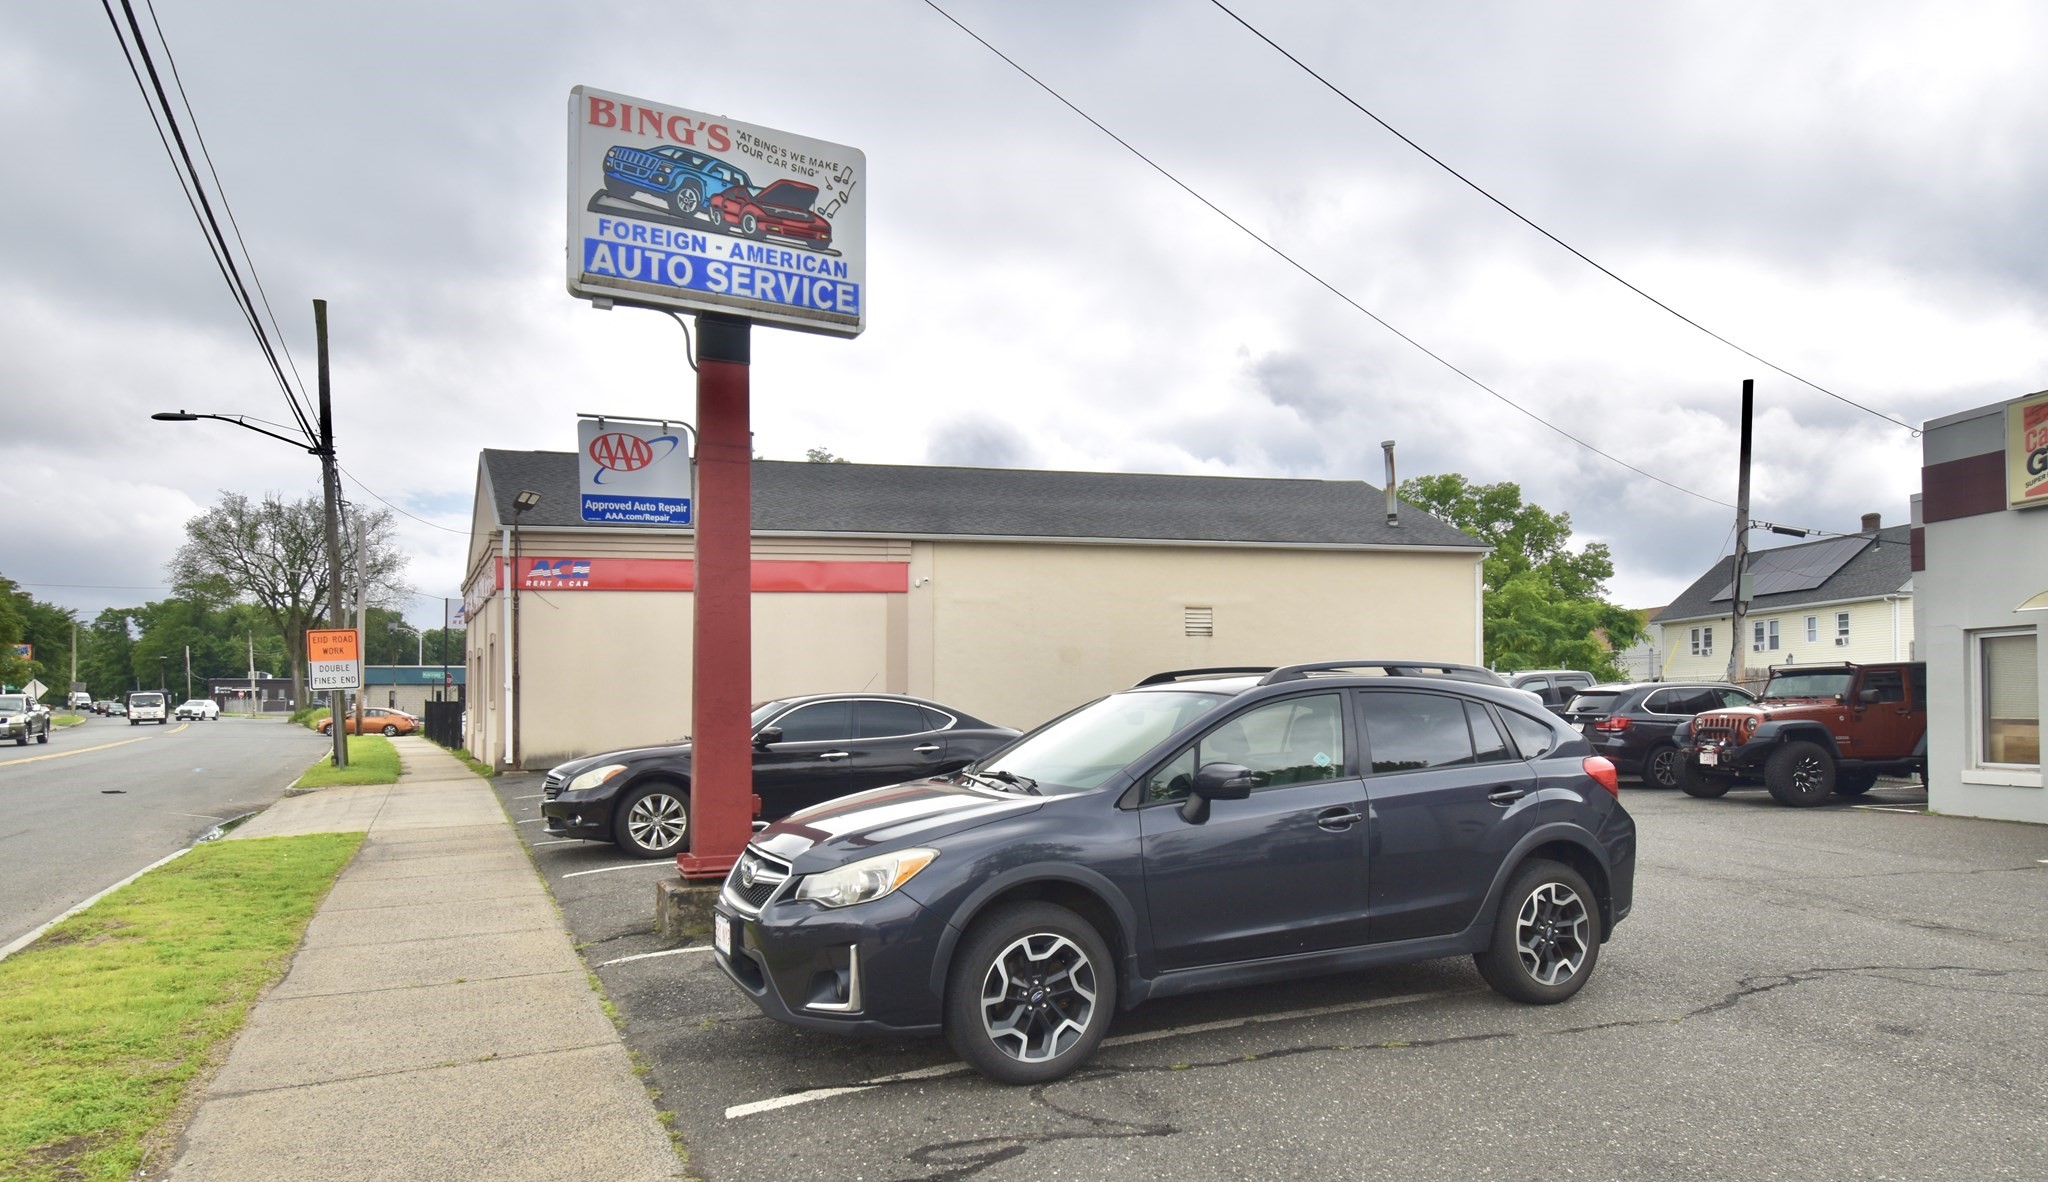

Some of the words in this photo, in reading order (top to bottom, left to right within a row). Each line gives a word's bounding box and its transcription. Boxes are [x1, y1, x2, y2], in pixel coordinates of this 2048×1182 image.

[588, 96, 731, 153] BING'S
[736, 140, 764, 160] YOUR
[766, 155, 788, 169] CAR
[753, 137, 787, 158] BING'S
[790, 151, 806, 164] WE
[808, 157, 839, 172] MAKE
[600, 218, 707, 253] FOREIGN
[729, 242, 847, 279] AMERICAN
[589, 243, 693, 287] AUTO
[706, 261, 857, 312] SERVICE
[597, 433, 648, 471] AAA
[2025, 473, 2046, 488] SUPER
[585, 499, 632, 511] Approved
[633, 501, 656, 512] Auto
[658, 503, 688, 514] Repair
[605, 512, 670, 523] AAA.com/Repair
[527, 560, 591, 579] ACE
[332, 635, 353, 643] ROAD
[322, 647, 344, 655] WORK
[319, 664, 351, 673] DOUBLE
[314, 676, 337, 684] FINES
[340, 676, 356, 684] END
